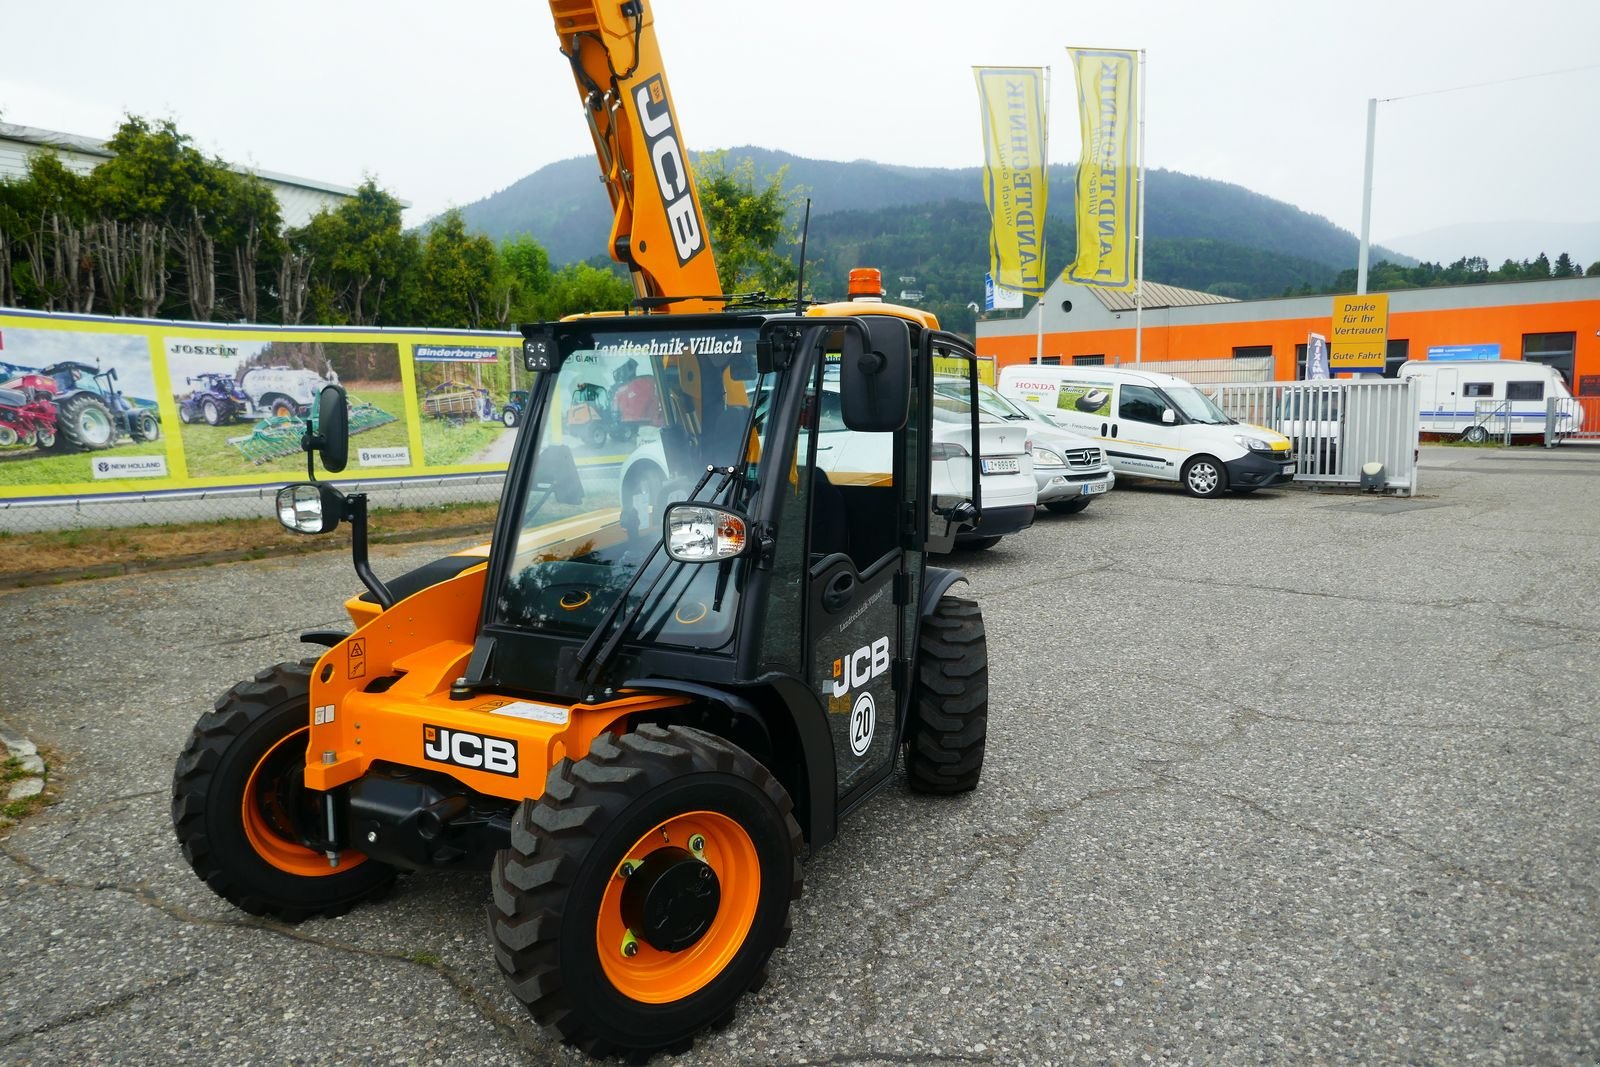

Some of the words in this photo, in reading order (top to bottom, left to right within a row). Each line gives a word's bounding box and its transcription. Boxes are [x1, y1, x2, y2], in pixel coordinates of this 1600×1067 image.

[637, 87, 701, 260] JCB
[1344, 303, 1376, 312] Danke
[1343, 315, 1357, 323] für
[1361, 314, 1375, 322] Ihr
[1335, 327, 1384, 335] Vertrauen
[171, 344, 238, 357] JOSKIN
[593, 335, 742, 356] Landtechnik-Villach
[417, 347, 496, 359] Binderberger
[1333, 352, 1355, 360] Gute
[1357, 352, 1382, 360] Fahrt
[1015, 382, 1056, 391] HONDA
[833, 635, 890, 698] JCB
[855, 706, 871, 744] 20
[425, 729, 517, 774] JCB
